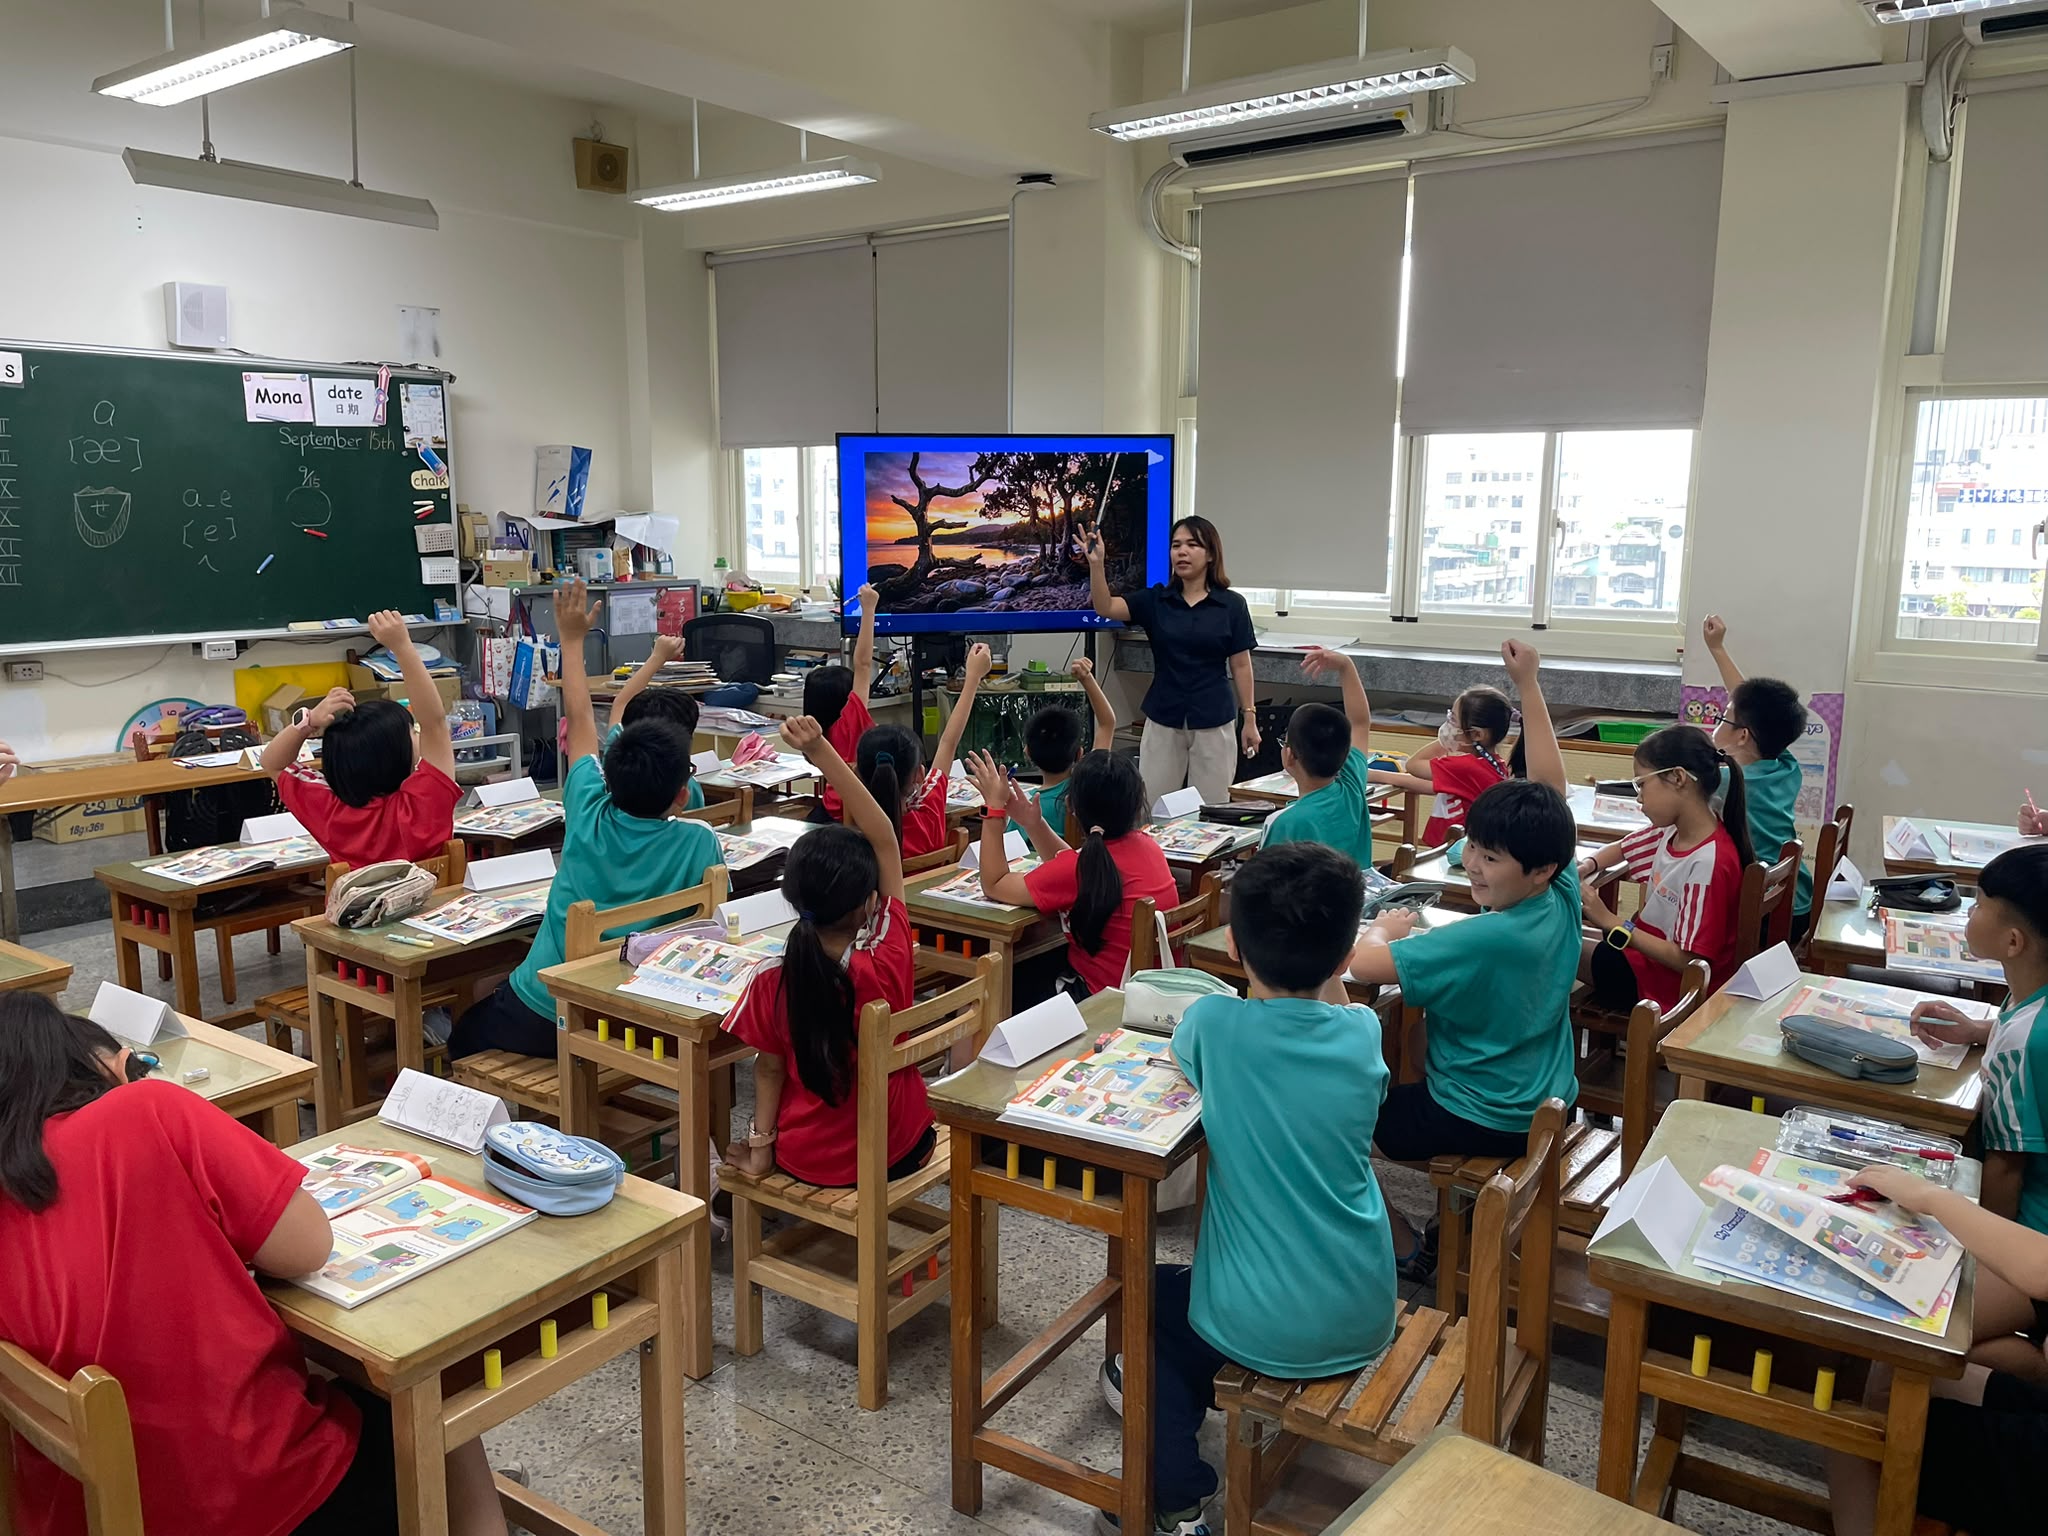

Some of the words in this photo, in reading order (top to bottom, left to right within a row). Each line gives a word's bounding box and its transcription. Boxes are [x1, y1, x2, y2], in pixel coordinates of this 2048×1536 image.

[255, 387, 303, 404] Mona
[327, 384, 363, 400] date
[93, 400, 115, 427] a
[336, 403, 359, 416] 日期
[279, 427, 362, 456] September
[369, 430, 395, 450] 15th
[298, 465, 321, 488] 9/15
[413, 473, 447, 487] chalk
